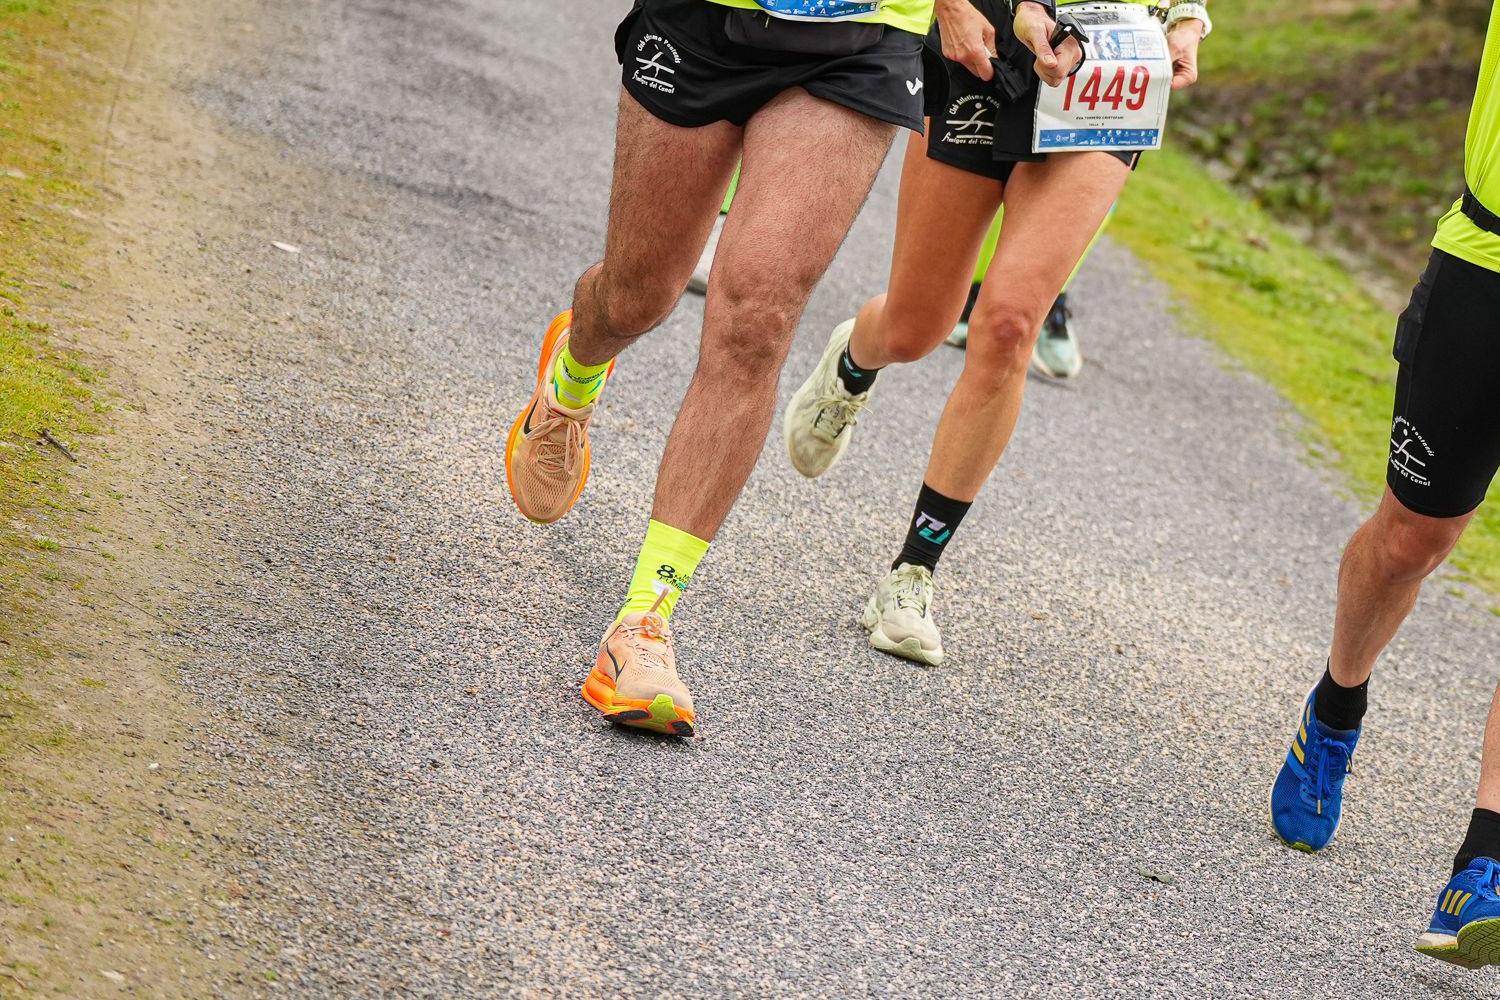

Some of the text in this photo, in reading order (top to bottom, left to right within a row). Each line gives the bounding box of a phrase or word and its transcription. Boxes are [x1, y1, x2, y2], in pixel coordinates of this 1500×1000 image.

[1063, 66, 1150, 111] 1449
[949, 104, 959, 115] Club
[941, 131, 967, 145] Amigos
[1410, 476, 1431, 487] Canal
